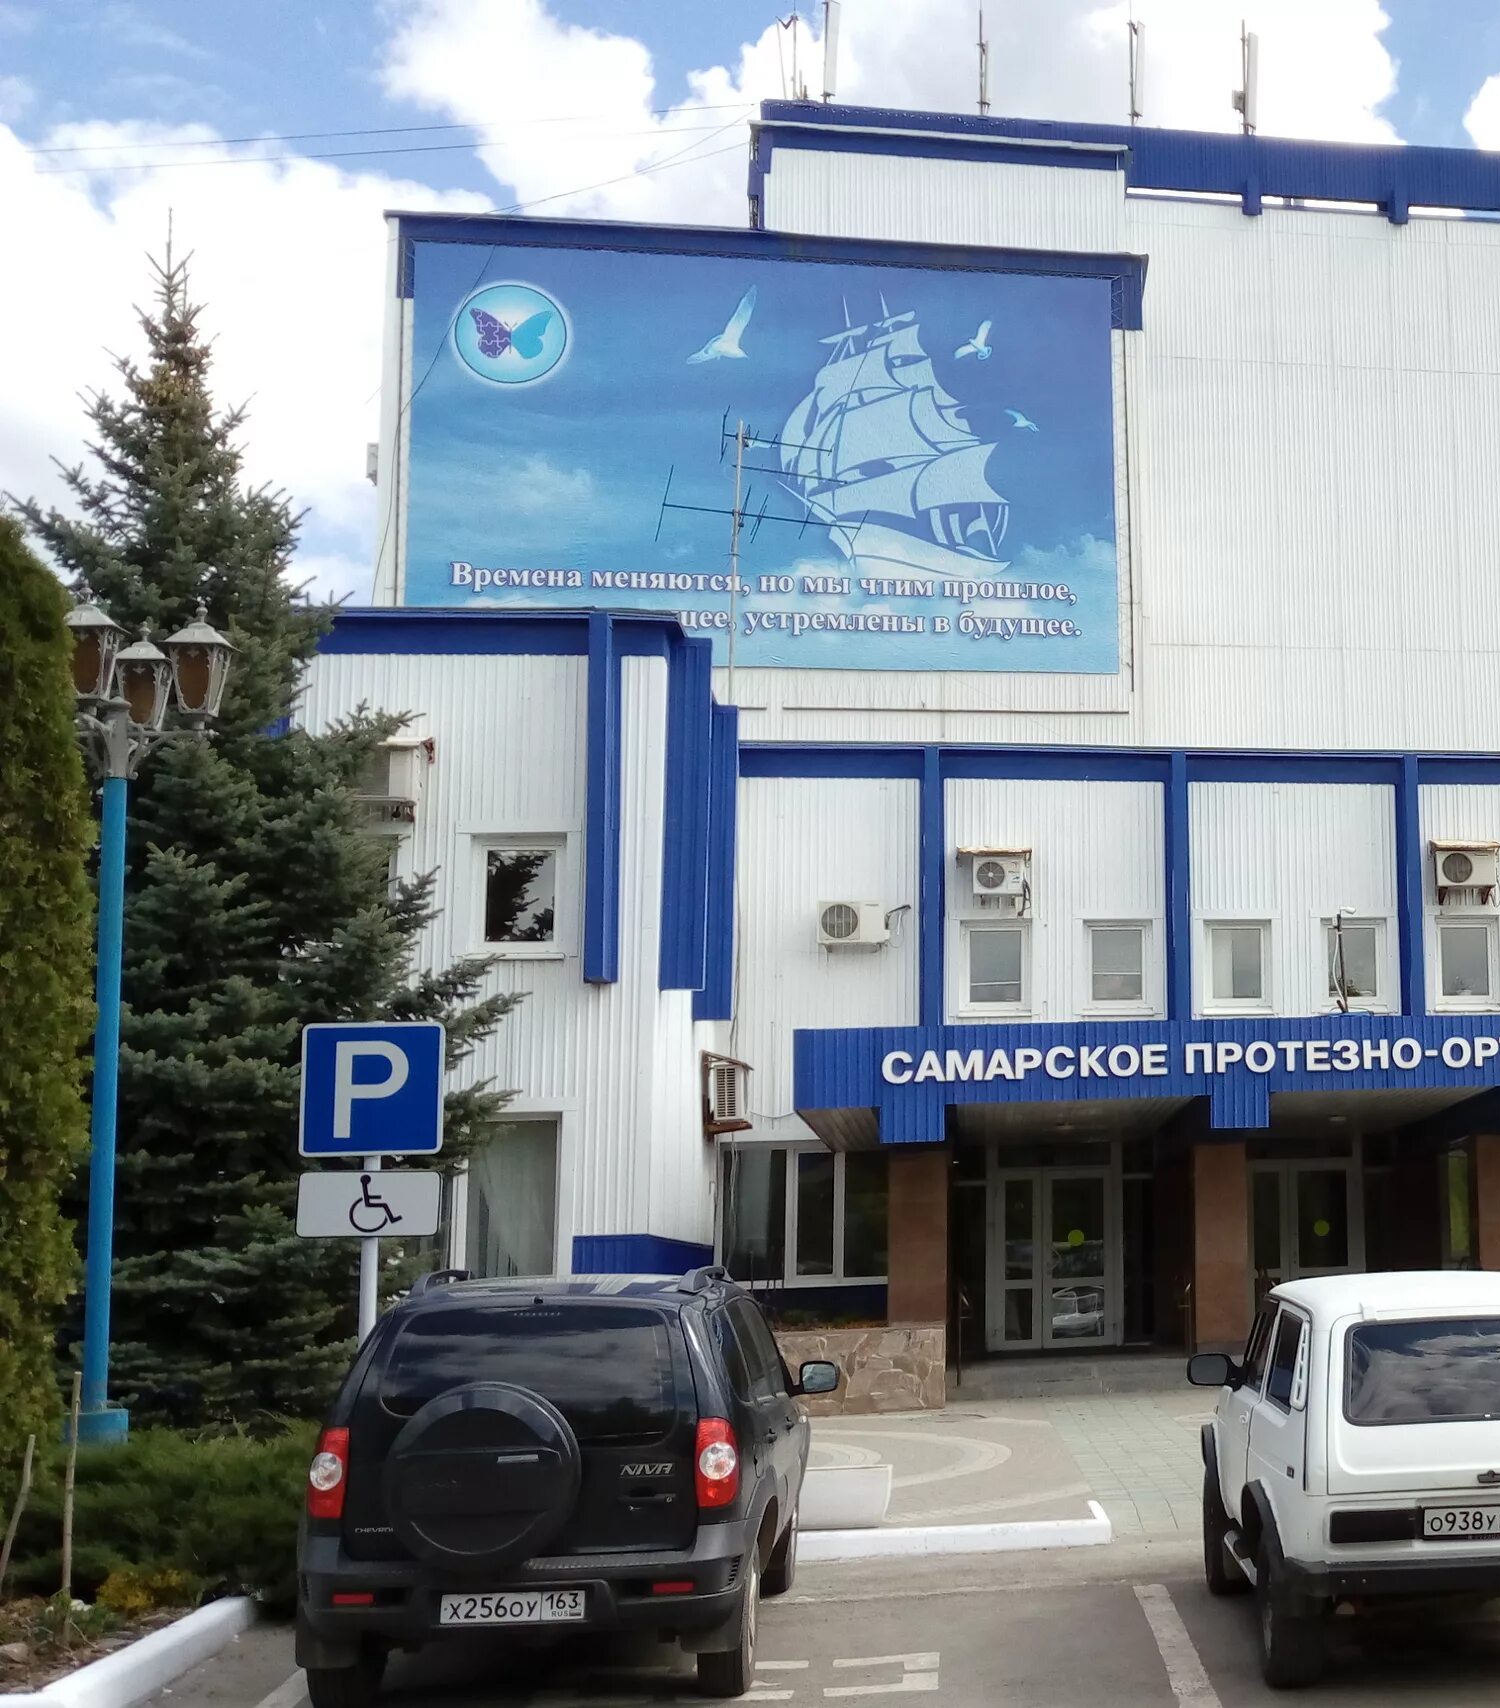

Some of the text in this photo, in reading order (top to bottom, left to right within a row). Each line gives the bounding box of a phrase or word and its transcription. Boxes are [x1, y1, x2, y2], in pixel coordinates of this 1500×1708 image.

[451, 561, 1078, 605] Времена меняются, но мы чтим прошлое,
[745, 611, 925, 636] устремлены
[933, 615, 950, 632] в
[959, 612, 1082, 640] будущее.
[881, 1043, 1168, 1085] САМАРСКОЕ
[333, 1040, 409, 1138] P
[620, 1463, 673, 1476] NIVA
[545, 1592, 579, 1610] 163
